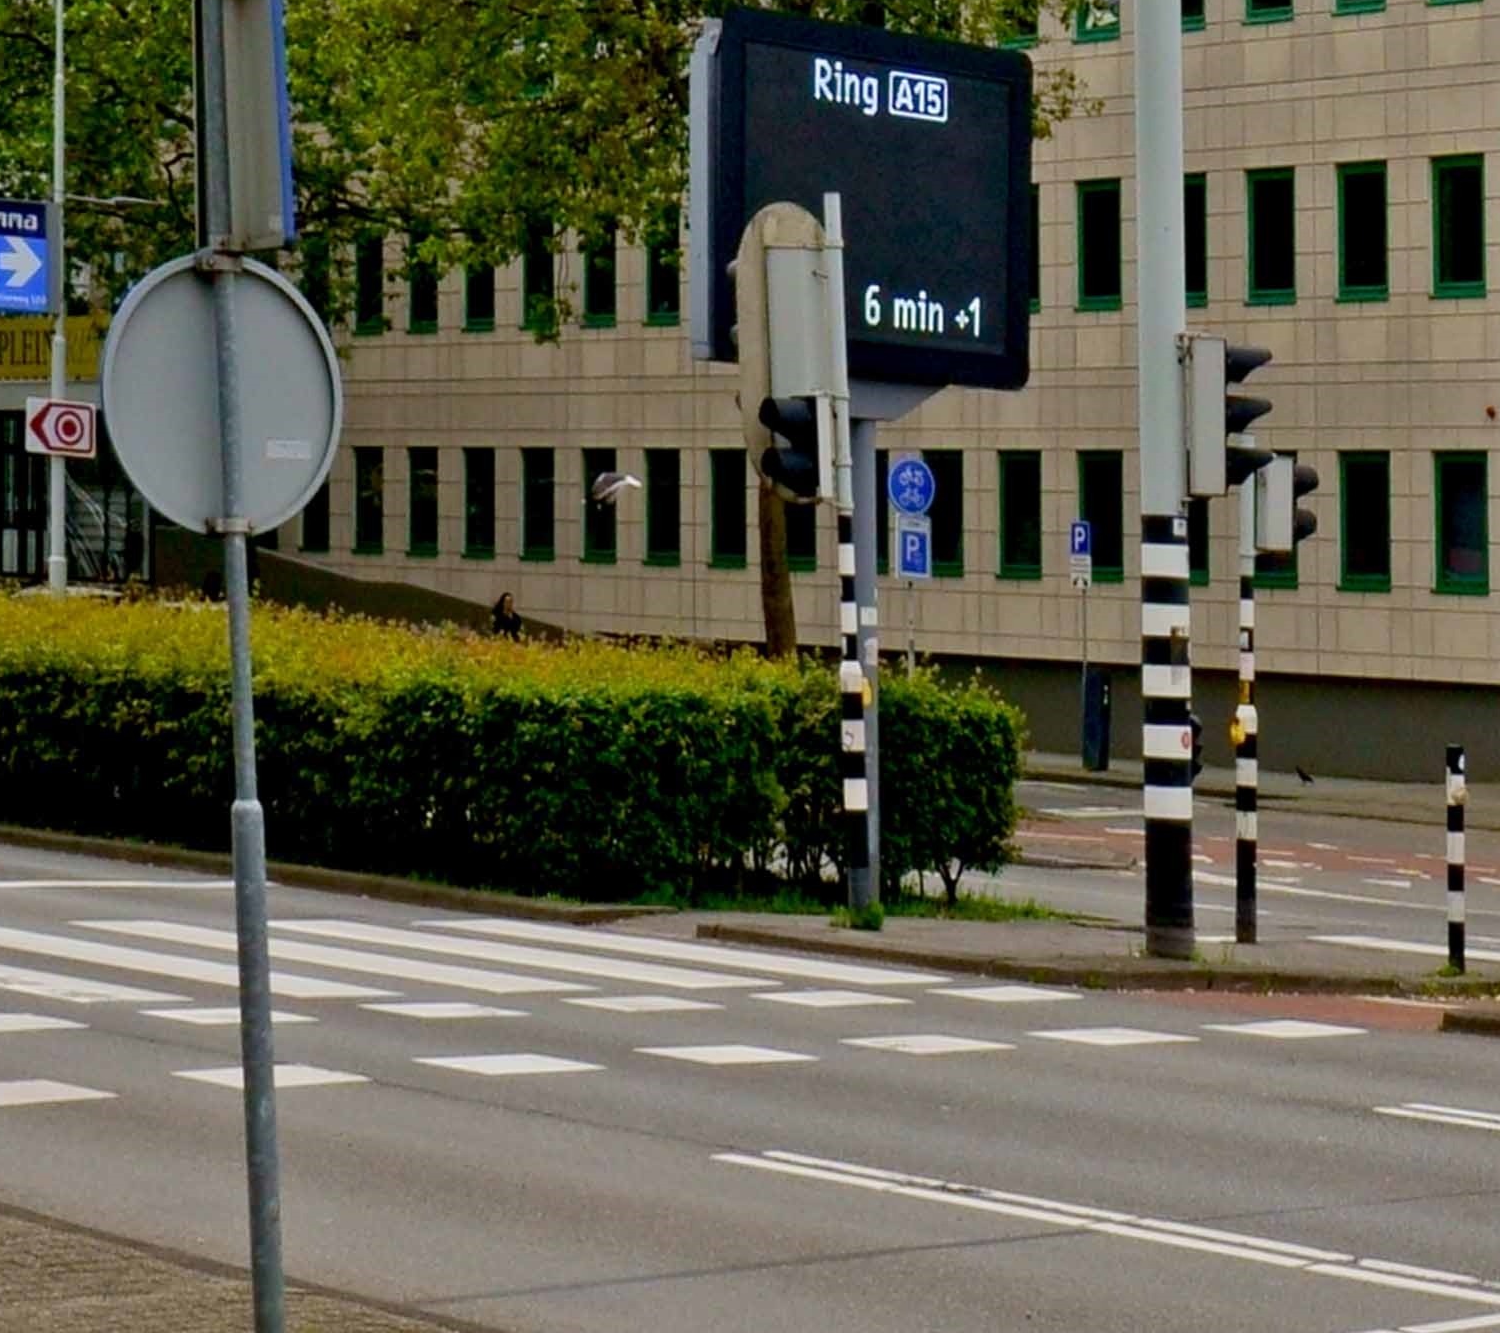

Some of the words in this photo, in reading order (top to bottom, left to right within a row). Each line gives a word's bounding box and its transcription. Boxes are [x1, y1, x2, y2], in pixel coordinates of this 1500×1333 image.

[813, 58, 879, 117] Ring
[894, 78, 942, 115] A15
[864, 283, 882, 326] 6
[893, 289, 944, 333] min
[954, 296, 981, 338] +1
[905, 534, 921, 562] P
[1073, 525, 1087, 551] P
